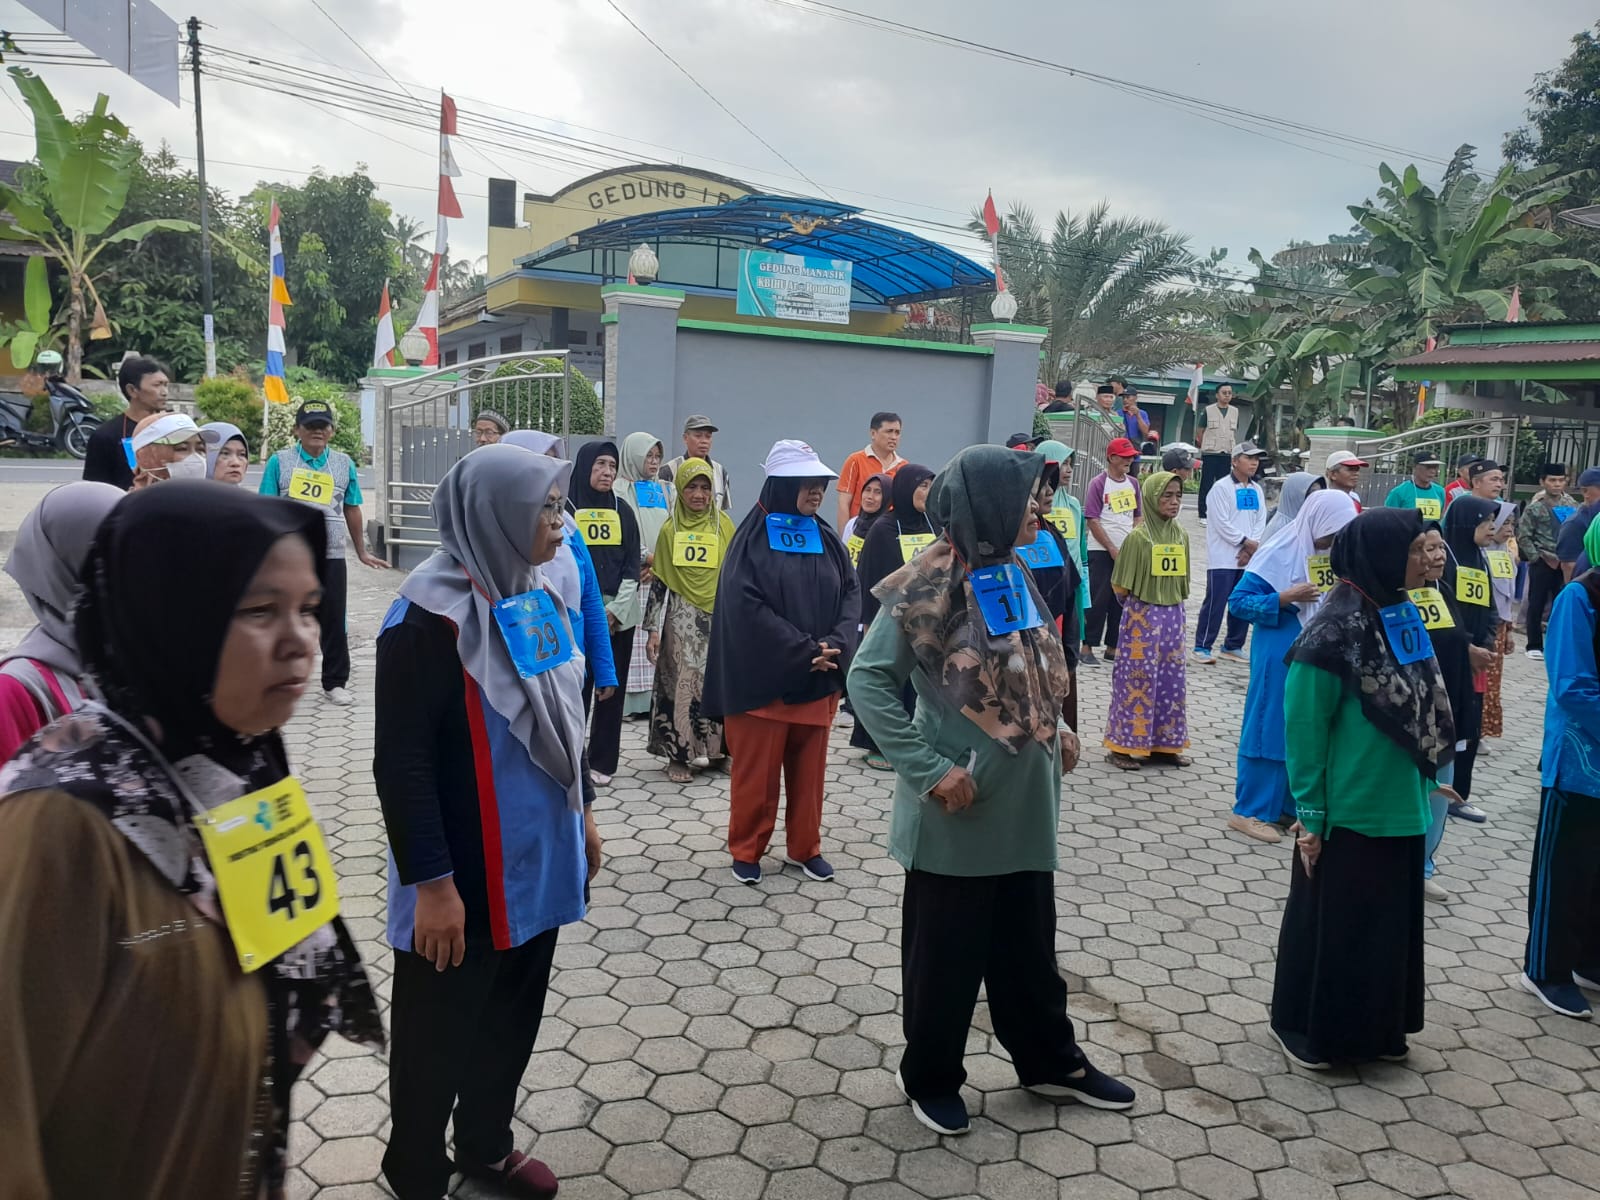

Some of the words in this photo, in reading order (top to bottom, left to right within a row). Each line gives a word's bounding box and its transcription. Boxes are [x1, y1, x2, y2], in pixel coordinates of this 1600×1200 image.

[588, 181, 686, 210] GEDUNG
[759, 262, 800, 275] GEDUNG
[801, 267, 846, 280] MANASIK
[301, 482, 321, 498] 20
[1119, 498, 1130, 509] 14
[1243, 497, 1254, 507] 13
[588, 524, 611, 540] 08
[780, 532, 807, 548] 09
[685, 546, 707, 562] 02
[1027, 546, 1052, 563] 03
[1162, 557, 1178, 571] 01
[1498, 561, 1513, 575] 15
[1316, 570, 1335, 587] 38
[1465, 582, 1484, 599] 30
[1418, 604, 1441, 624] 09
[526, 621, 560, 661] 29
[1401, 626, 1421, 655] 07
[267, 840, 322, 921] 43
